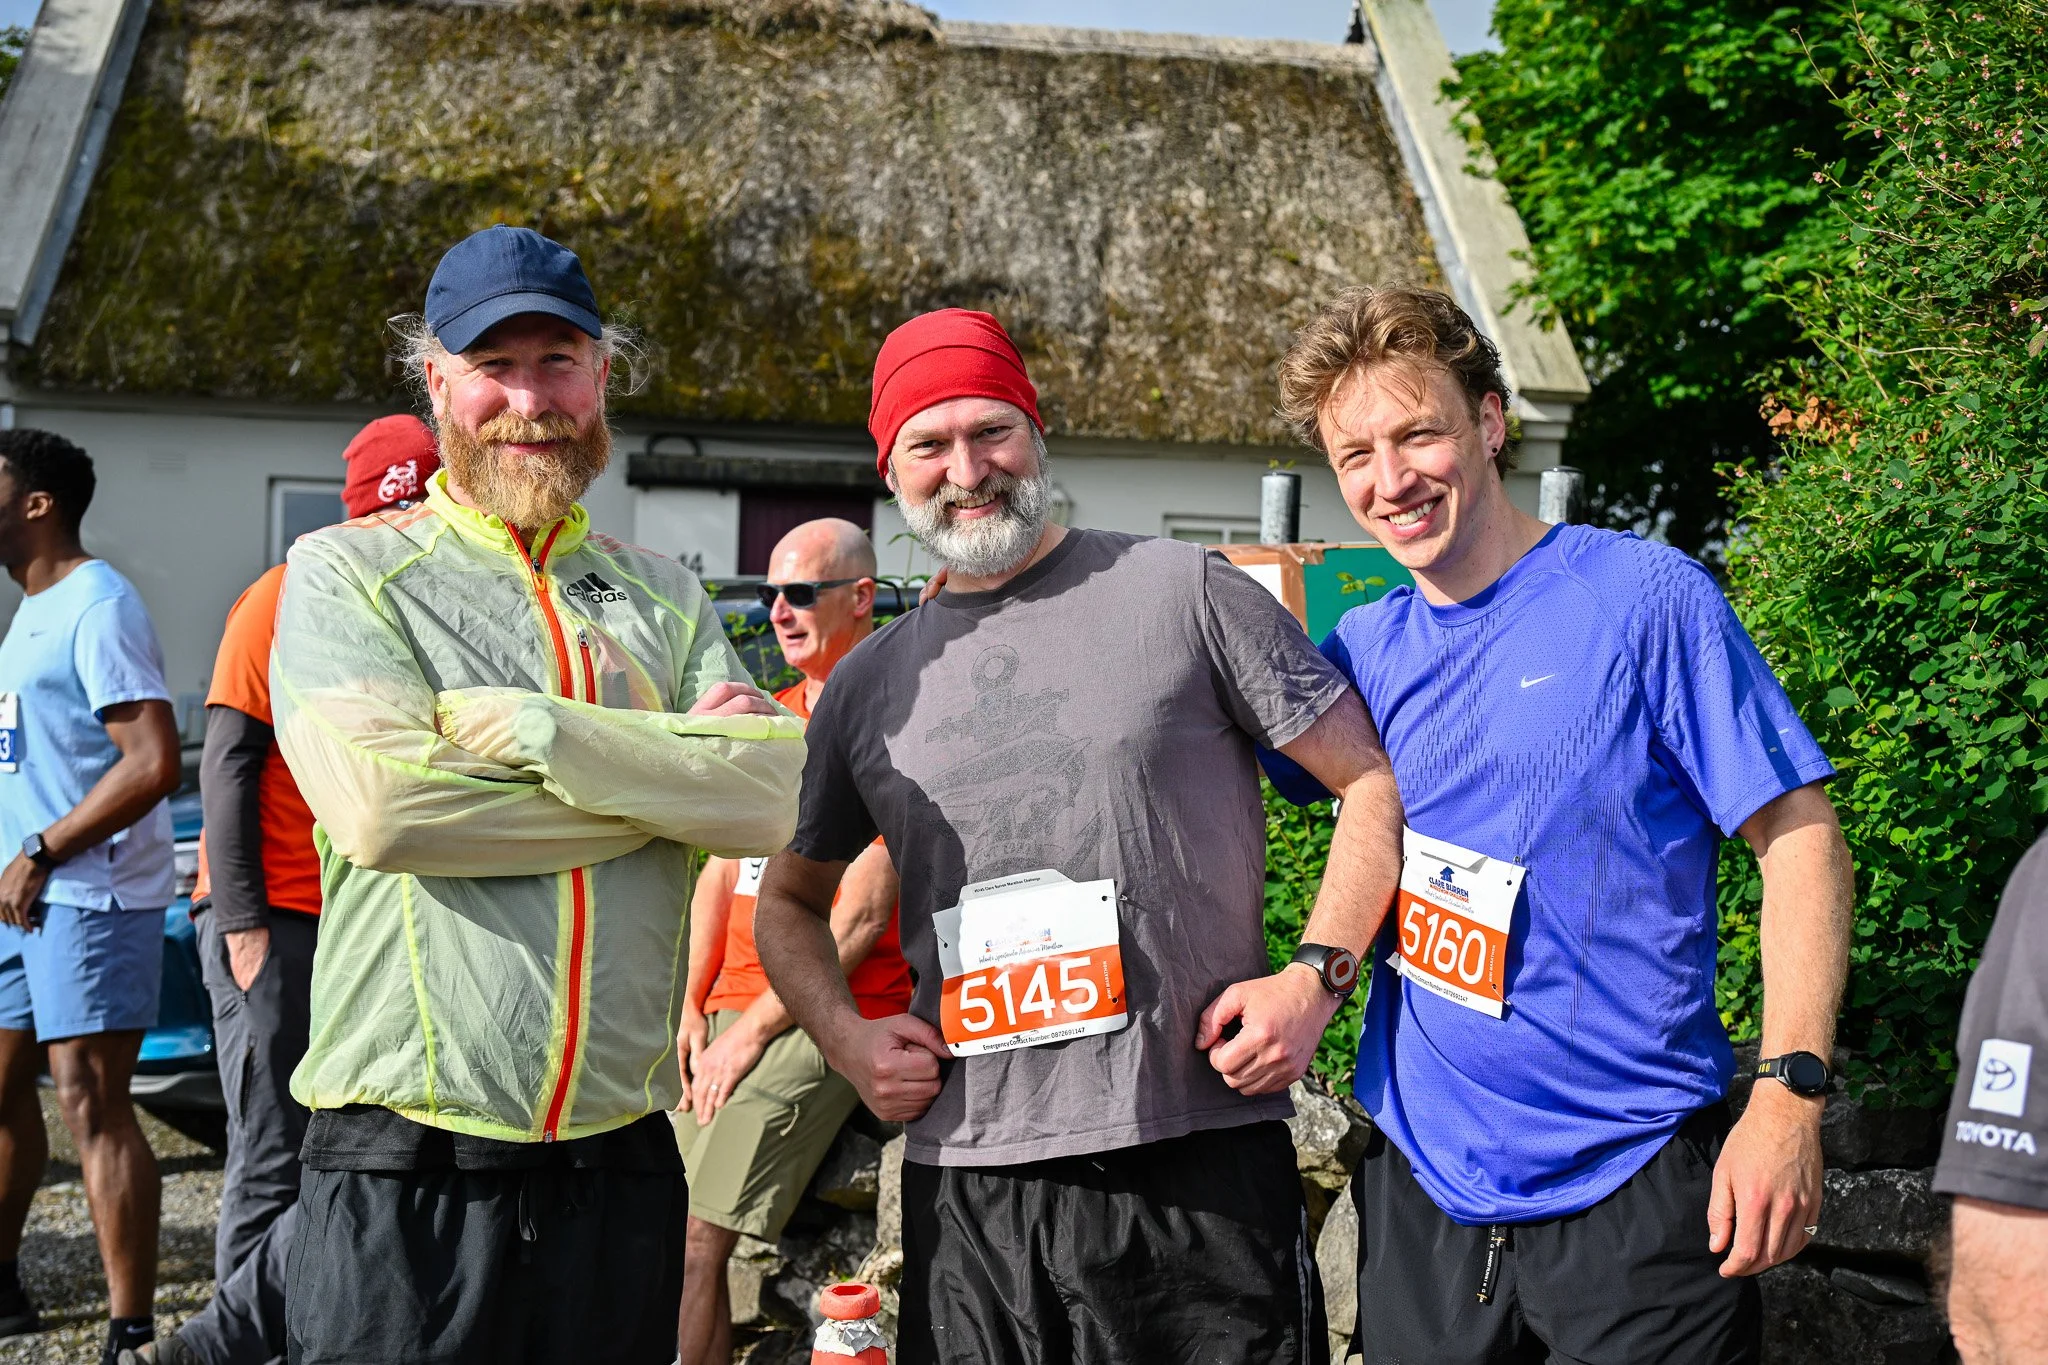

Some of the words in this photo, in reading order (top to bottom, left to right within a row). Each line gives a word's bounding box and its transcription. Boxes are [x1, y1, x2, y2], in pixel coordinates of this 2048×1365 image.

[566, 585, 628, 604] adidas
[0, 729, 11, 761] 3
[1006, 879, 1023, 887] Marathon
[1445, 882, 1469, 898] BURREN
[1401, 900, 1487, 985] 5160
[1102, 960, 1111, 988] MARATHON
[959, 956, 1099, 1033] 5145
[982, 1040, 1010, 1051] Emergency
[1050, 1027, 1086, 1039] 0872691147
